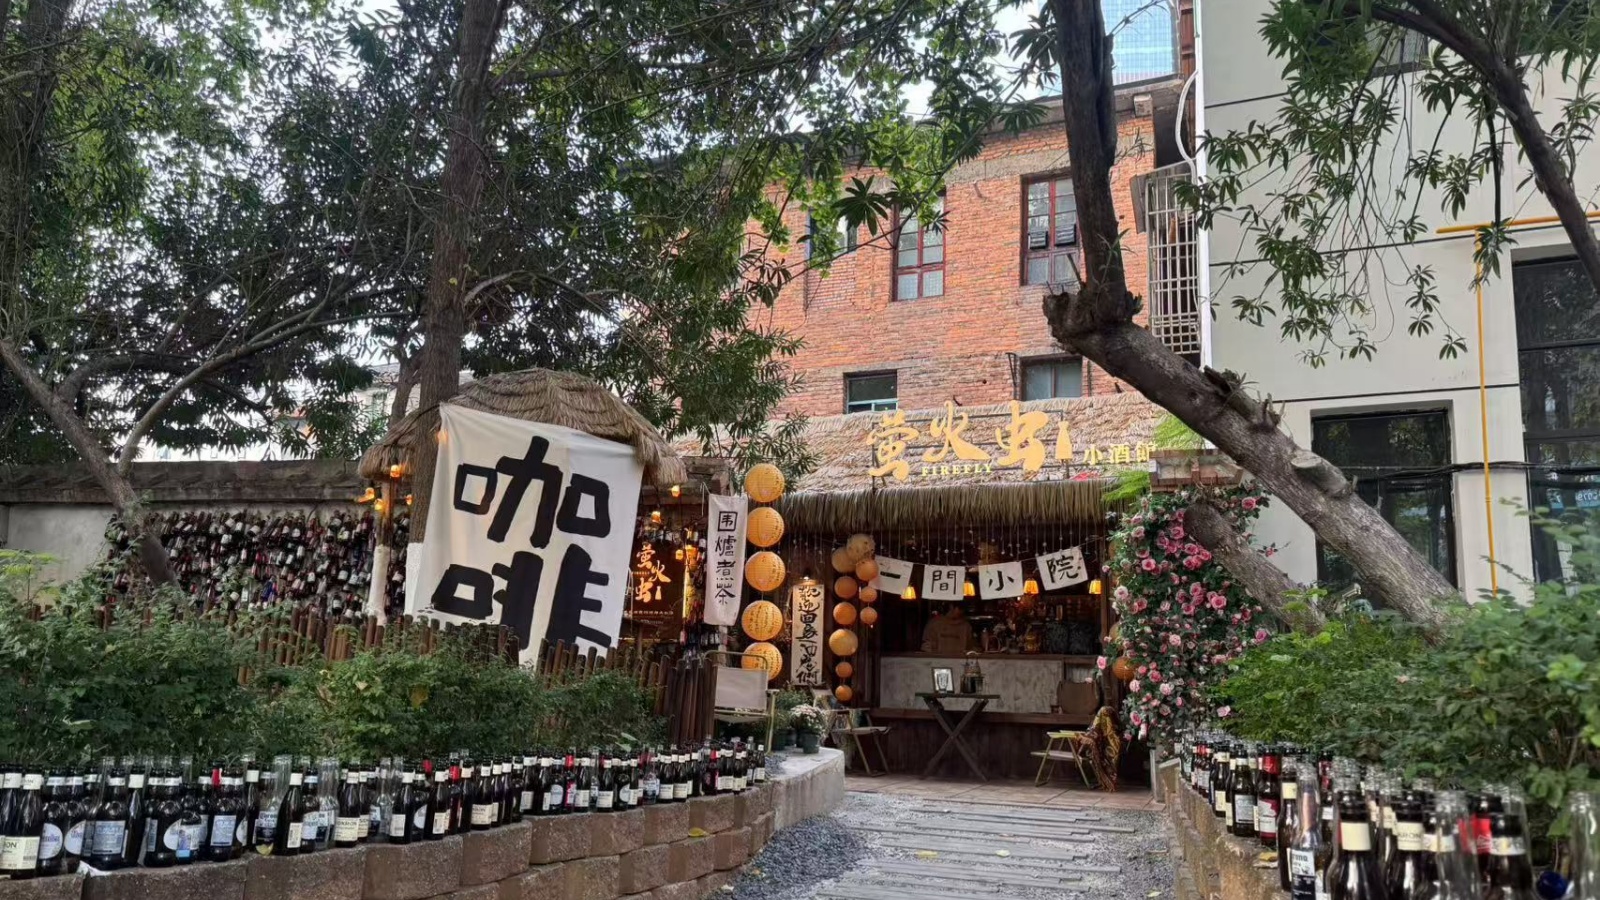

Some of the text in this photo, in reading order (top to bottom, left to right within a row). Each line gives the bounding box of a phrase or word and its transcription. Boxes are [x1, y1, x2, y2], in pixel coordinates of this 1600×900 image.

[921, 463, 992, 477] FIREFLY
[431, 435, 611, 651] 咖啡
[880, 554, 1080, 595] 一間小院
